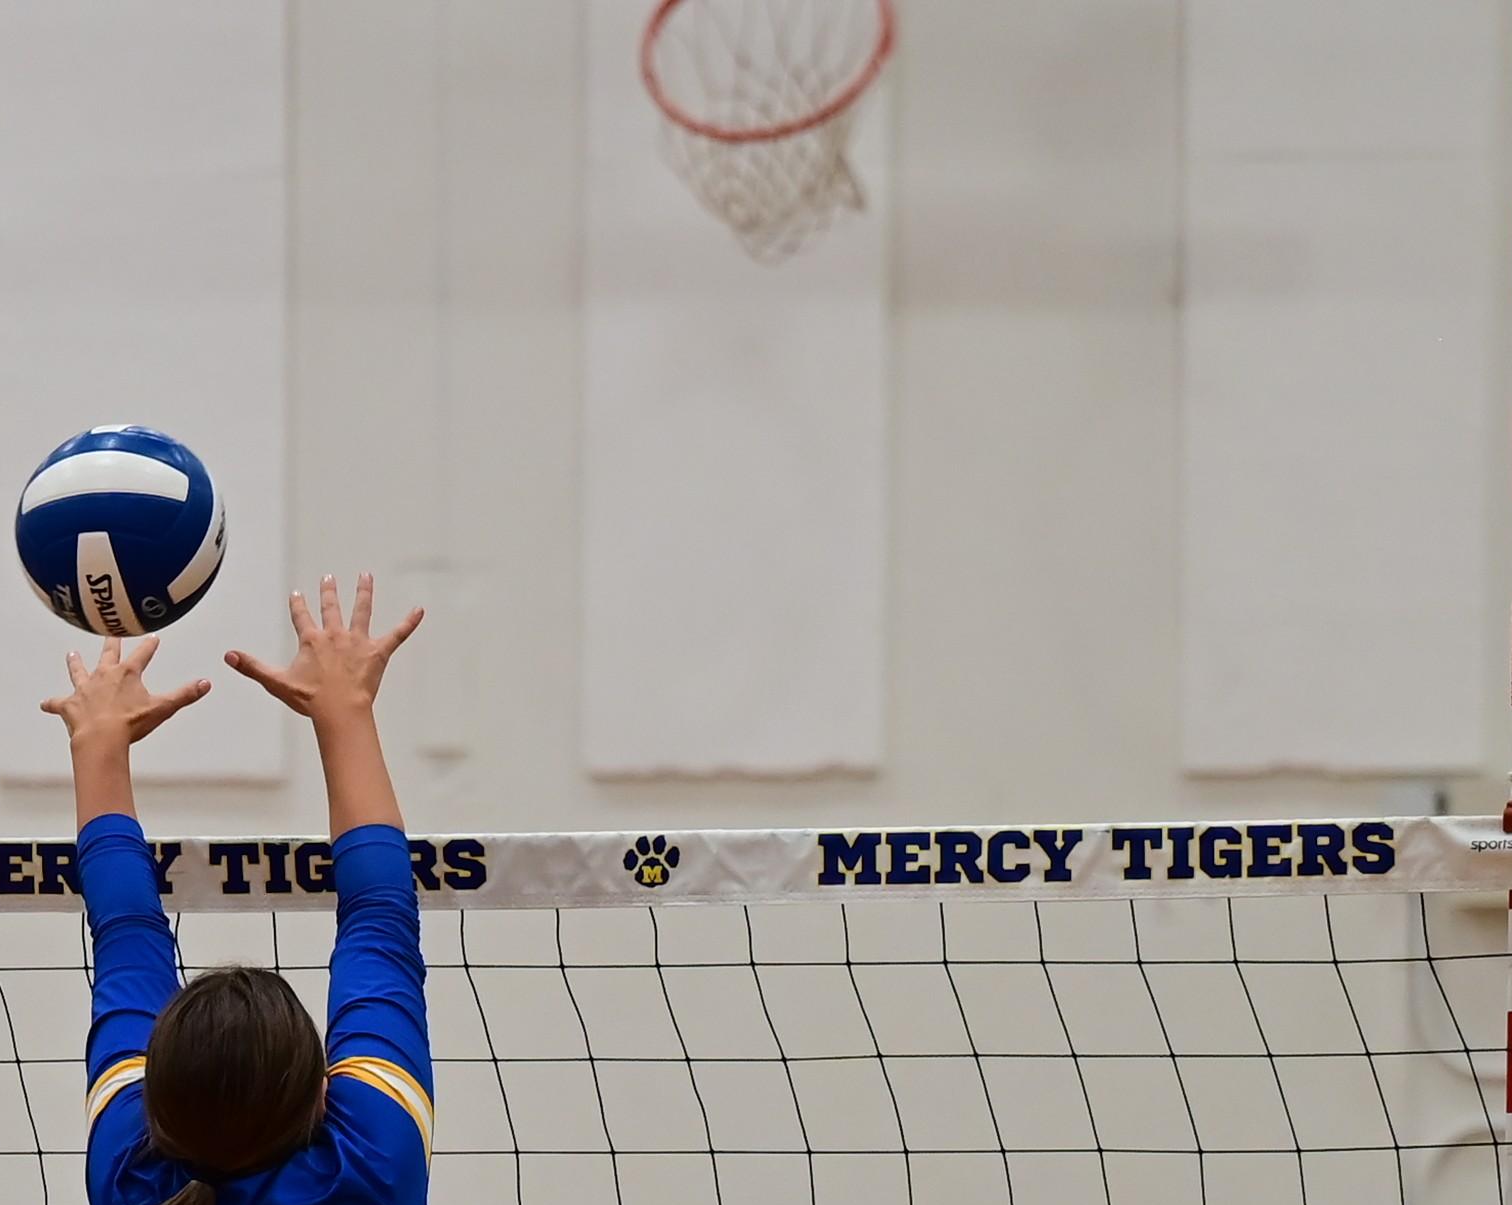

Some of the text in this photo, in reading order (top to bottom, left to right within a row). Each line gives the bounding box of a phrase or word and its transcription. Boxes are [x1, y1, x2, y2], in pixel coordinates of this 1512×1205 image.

[209, 838, 487, 895] TIGRS
[818, 823, 1396, 886] MERCY TIGERS
